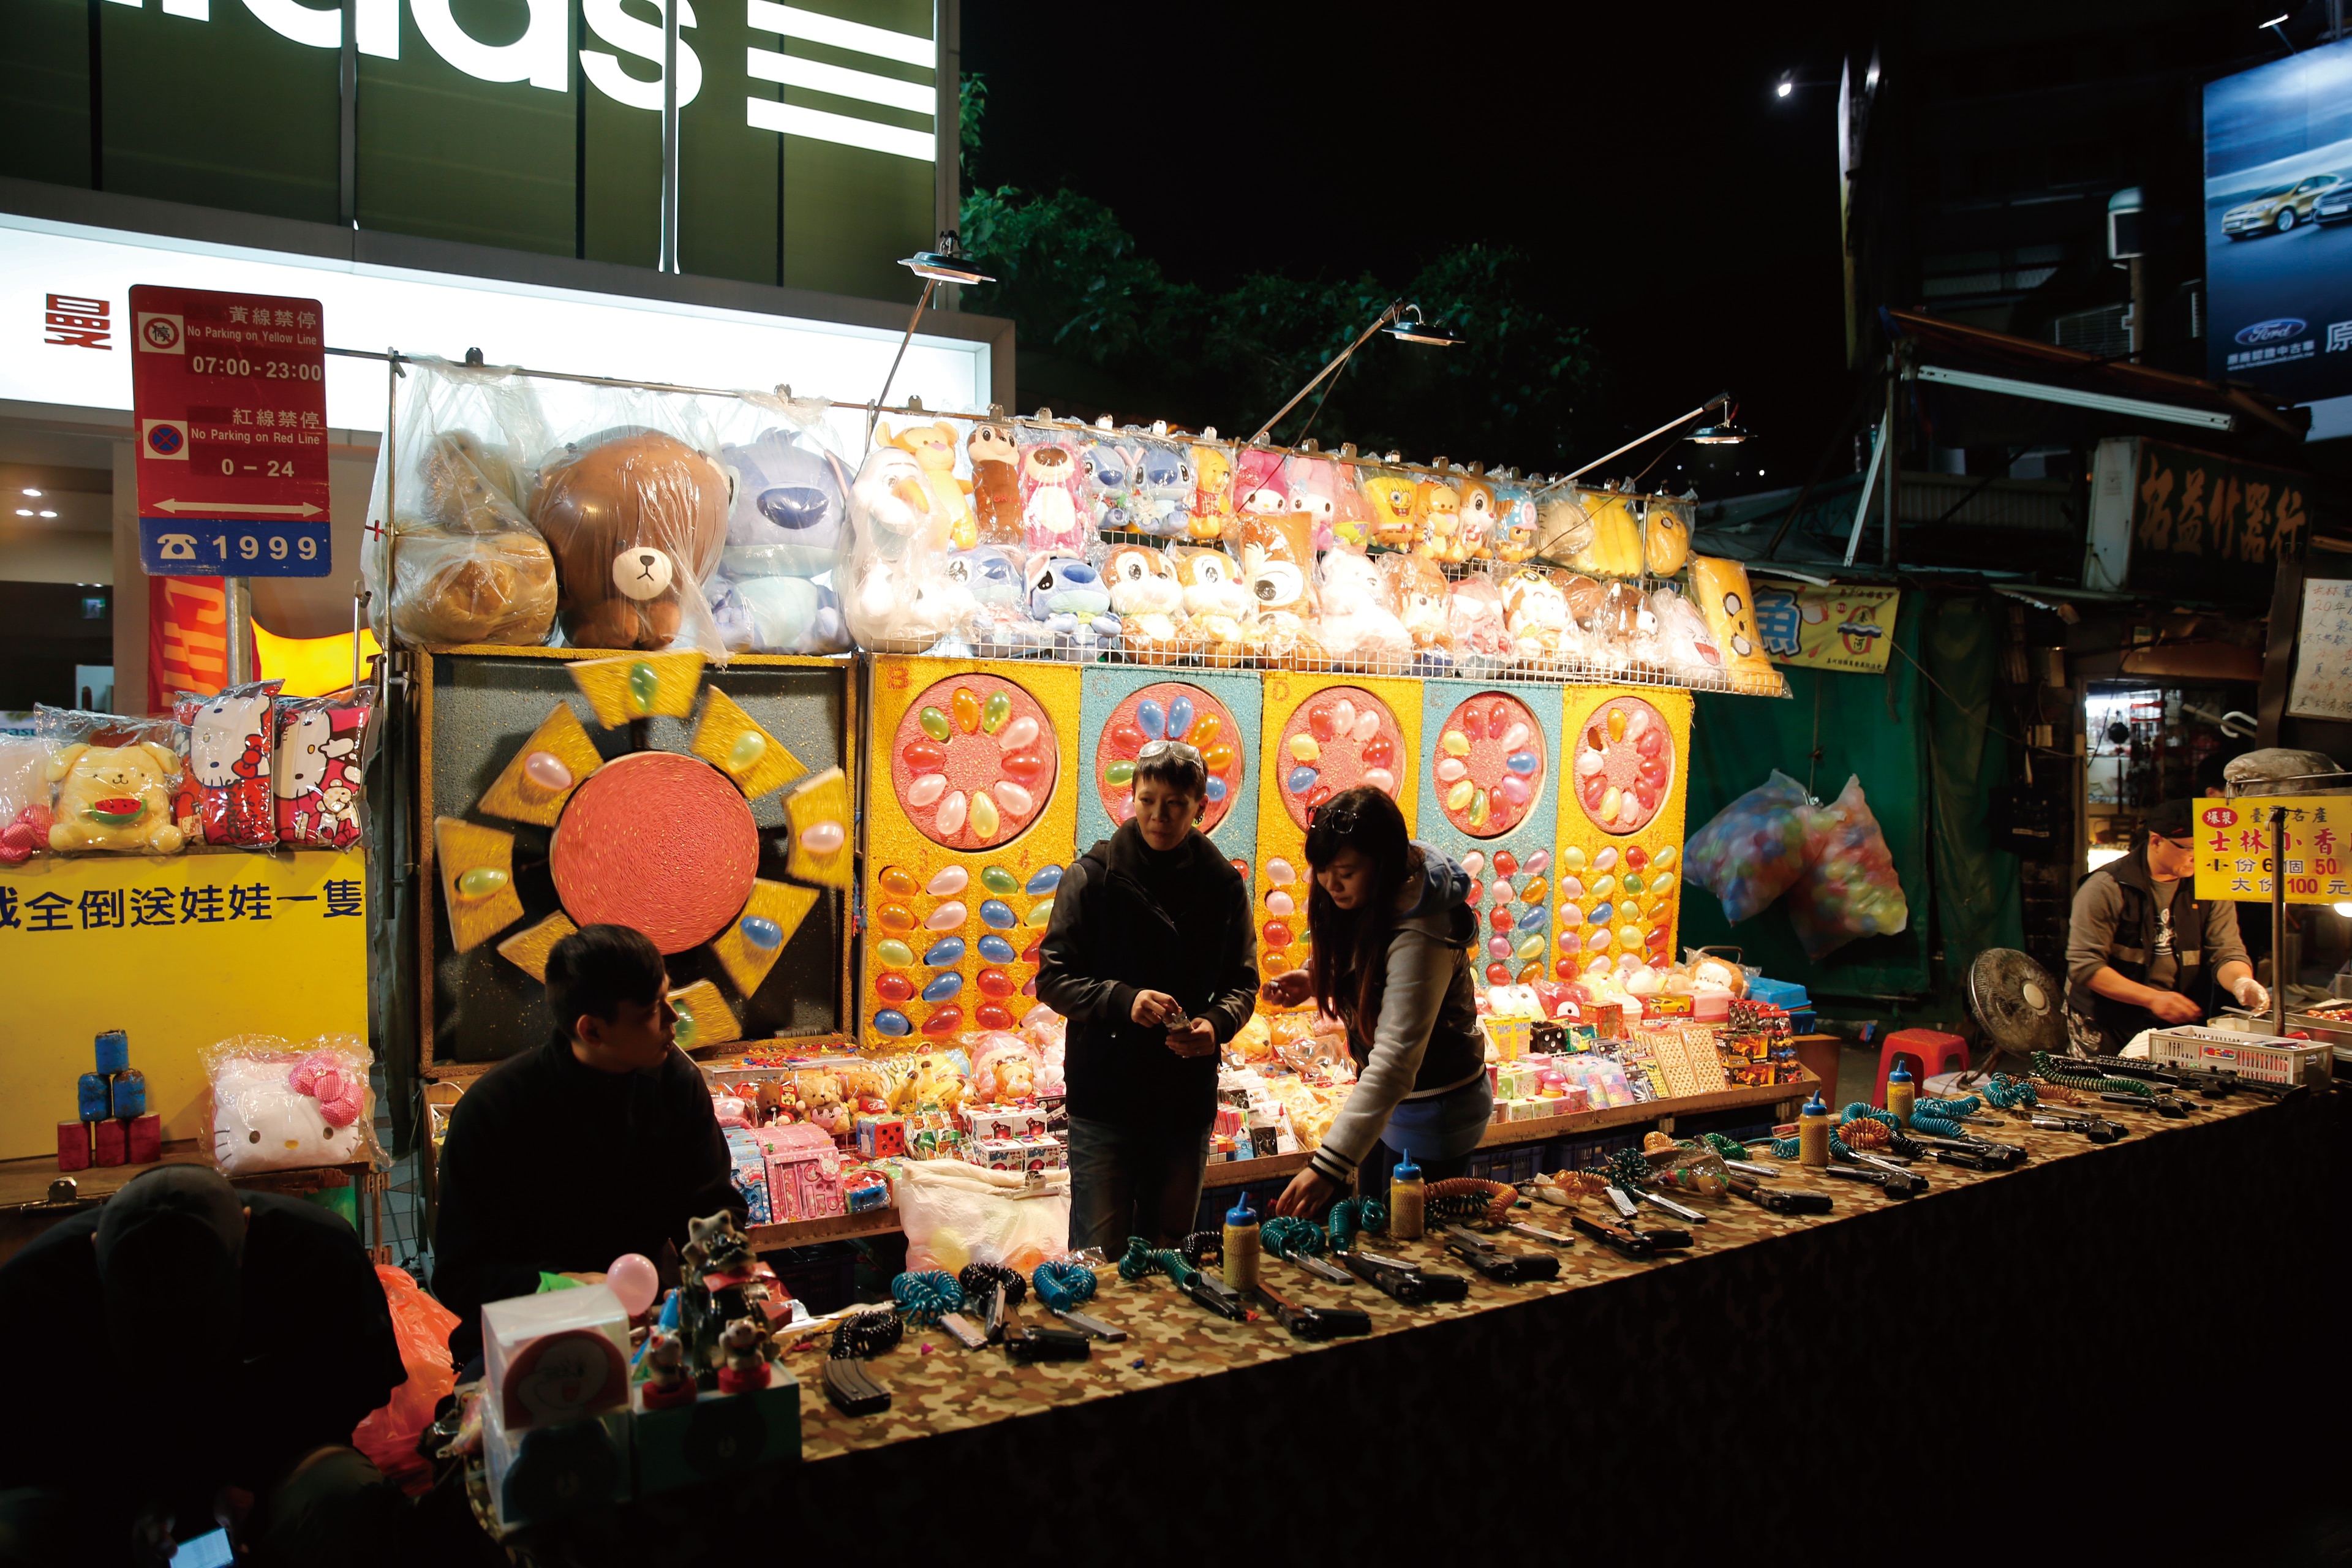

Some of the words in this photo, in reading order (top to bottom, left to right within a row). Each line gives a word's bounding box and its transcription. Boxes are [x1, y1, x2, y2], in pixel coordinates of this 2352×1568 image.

[45, 294, 112, 350] 曼
[229, 306, 316, 330] 黃線禁停
[187, 325, 201, 336] No
[206, 326, 241, 342] Parking
[247, 333, 258, 341] on
[262, 332, 293, 344] Yellow
[297, 334, 317, 345] Line
[2248, 322, 2293, 344] Ford
[233, 407, 319, 429] 紅線禁停
[191, 428, 206, 439] No
[211, 429, 251, 444] Parking
[255, 433, 268, 442] on
[274, 432, 293, 443] Red
[298, 433, 320, 445] Line
[212, 535, 317, 560] 1999
[2207, 811, 2233, 824] 爆漿
[2250, 807, 2328, 823] 臺名產
[2208, 827, 2352, 855] 士林小香
